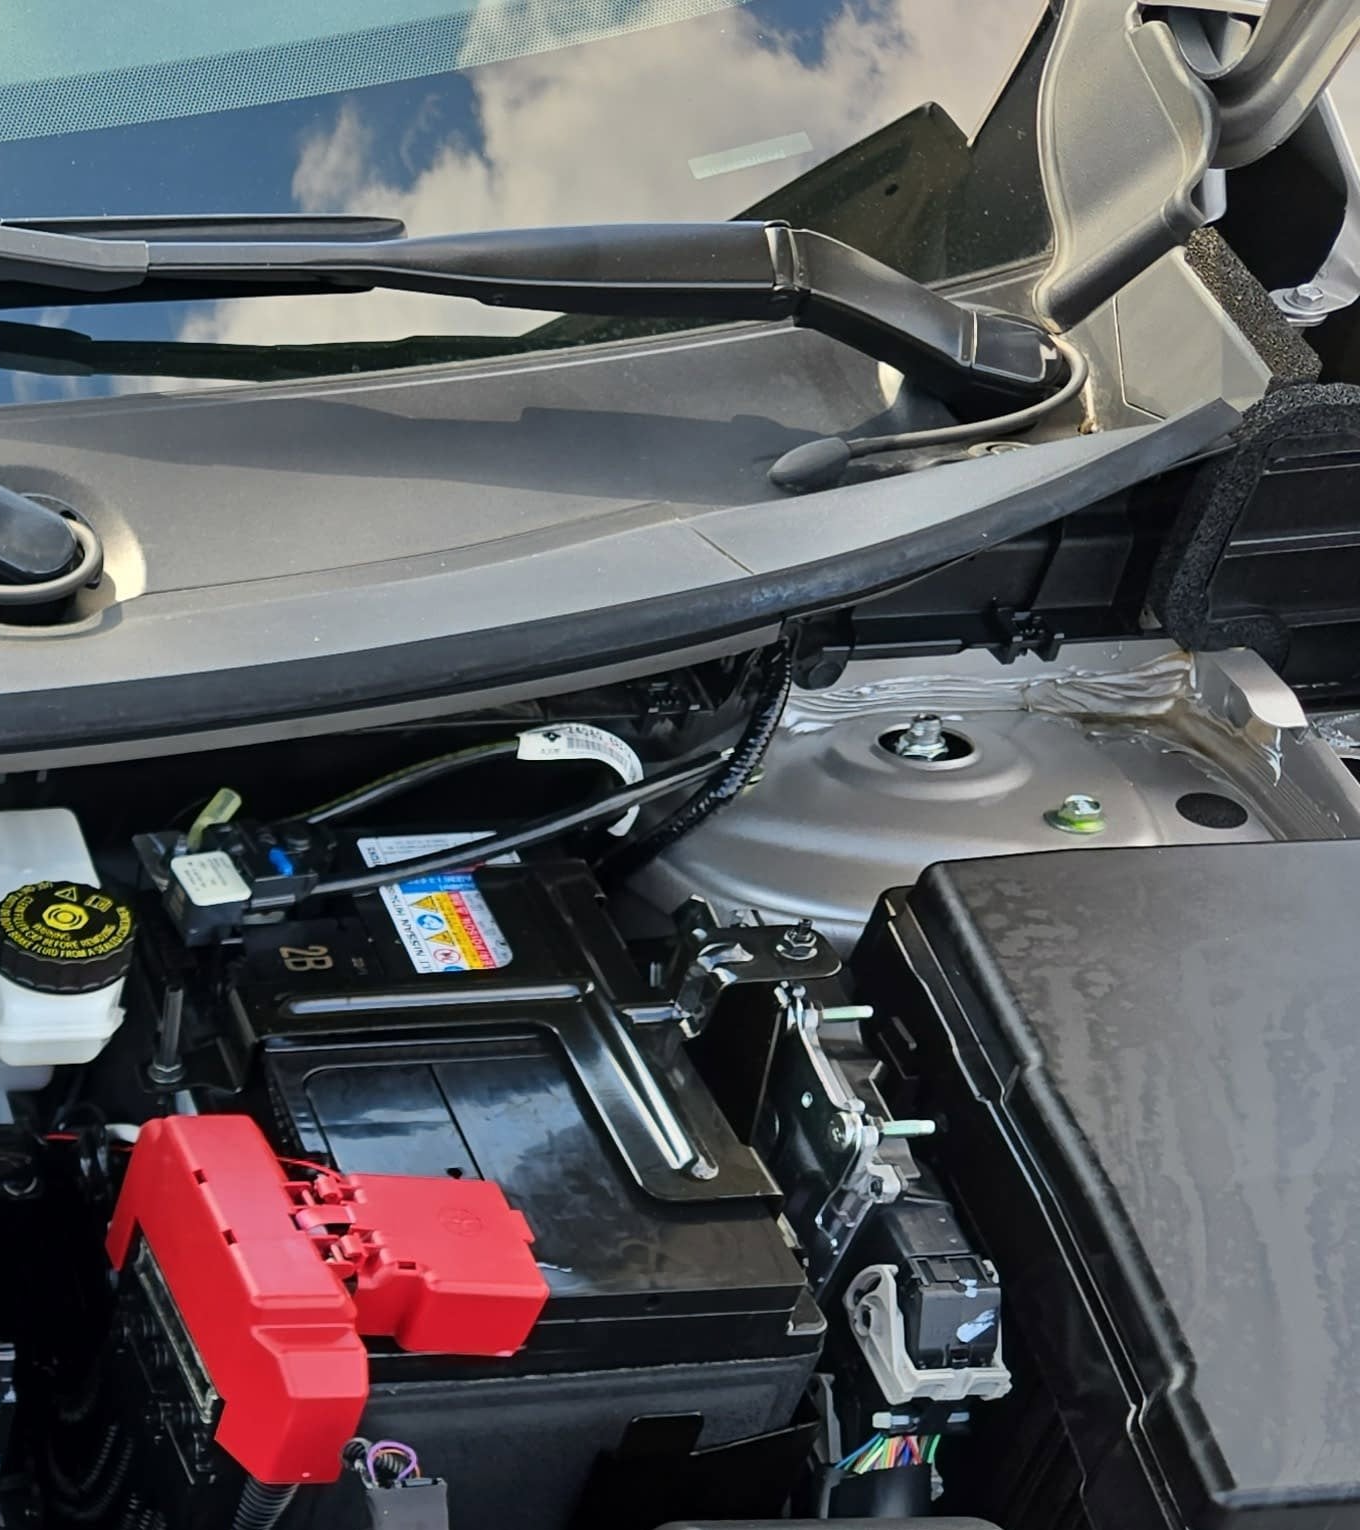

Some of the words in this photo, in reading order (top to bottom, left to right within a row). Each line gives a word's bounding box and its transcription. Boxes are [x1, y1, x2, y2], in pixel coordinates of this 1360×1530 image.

[41, 937, 79, 950] BEFORE
[31, 944, 59, 958] FLUID
[60, 948, 87, 958] FROM
